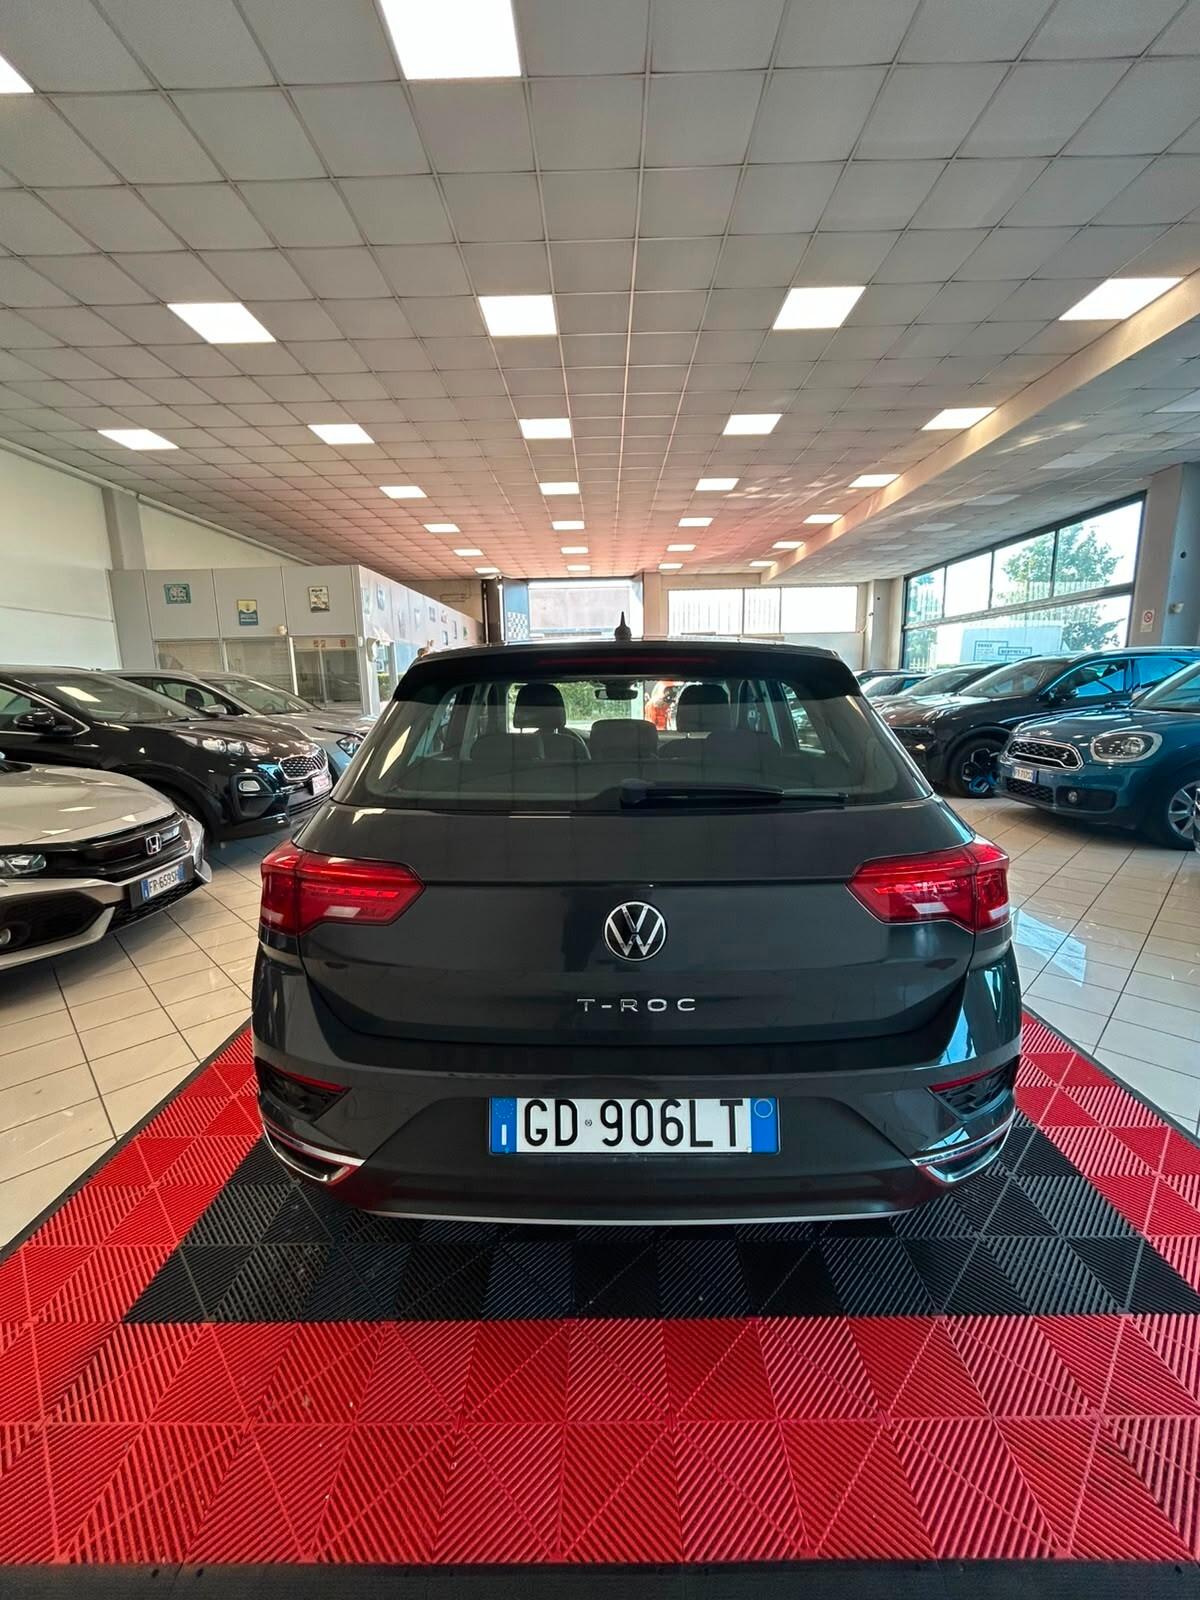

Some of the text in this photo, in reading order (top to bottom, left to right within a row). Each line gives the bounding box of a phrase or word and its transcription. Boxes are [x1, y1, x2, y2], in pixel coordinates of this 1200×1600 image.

[577, 998, 696, 1012] T-ROC
[524, 1099, 578, 1147] GD
[600, 1099, 744, 1147] 906LT
